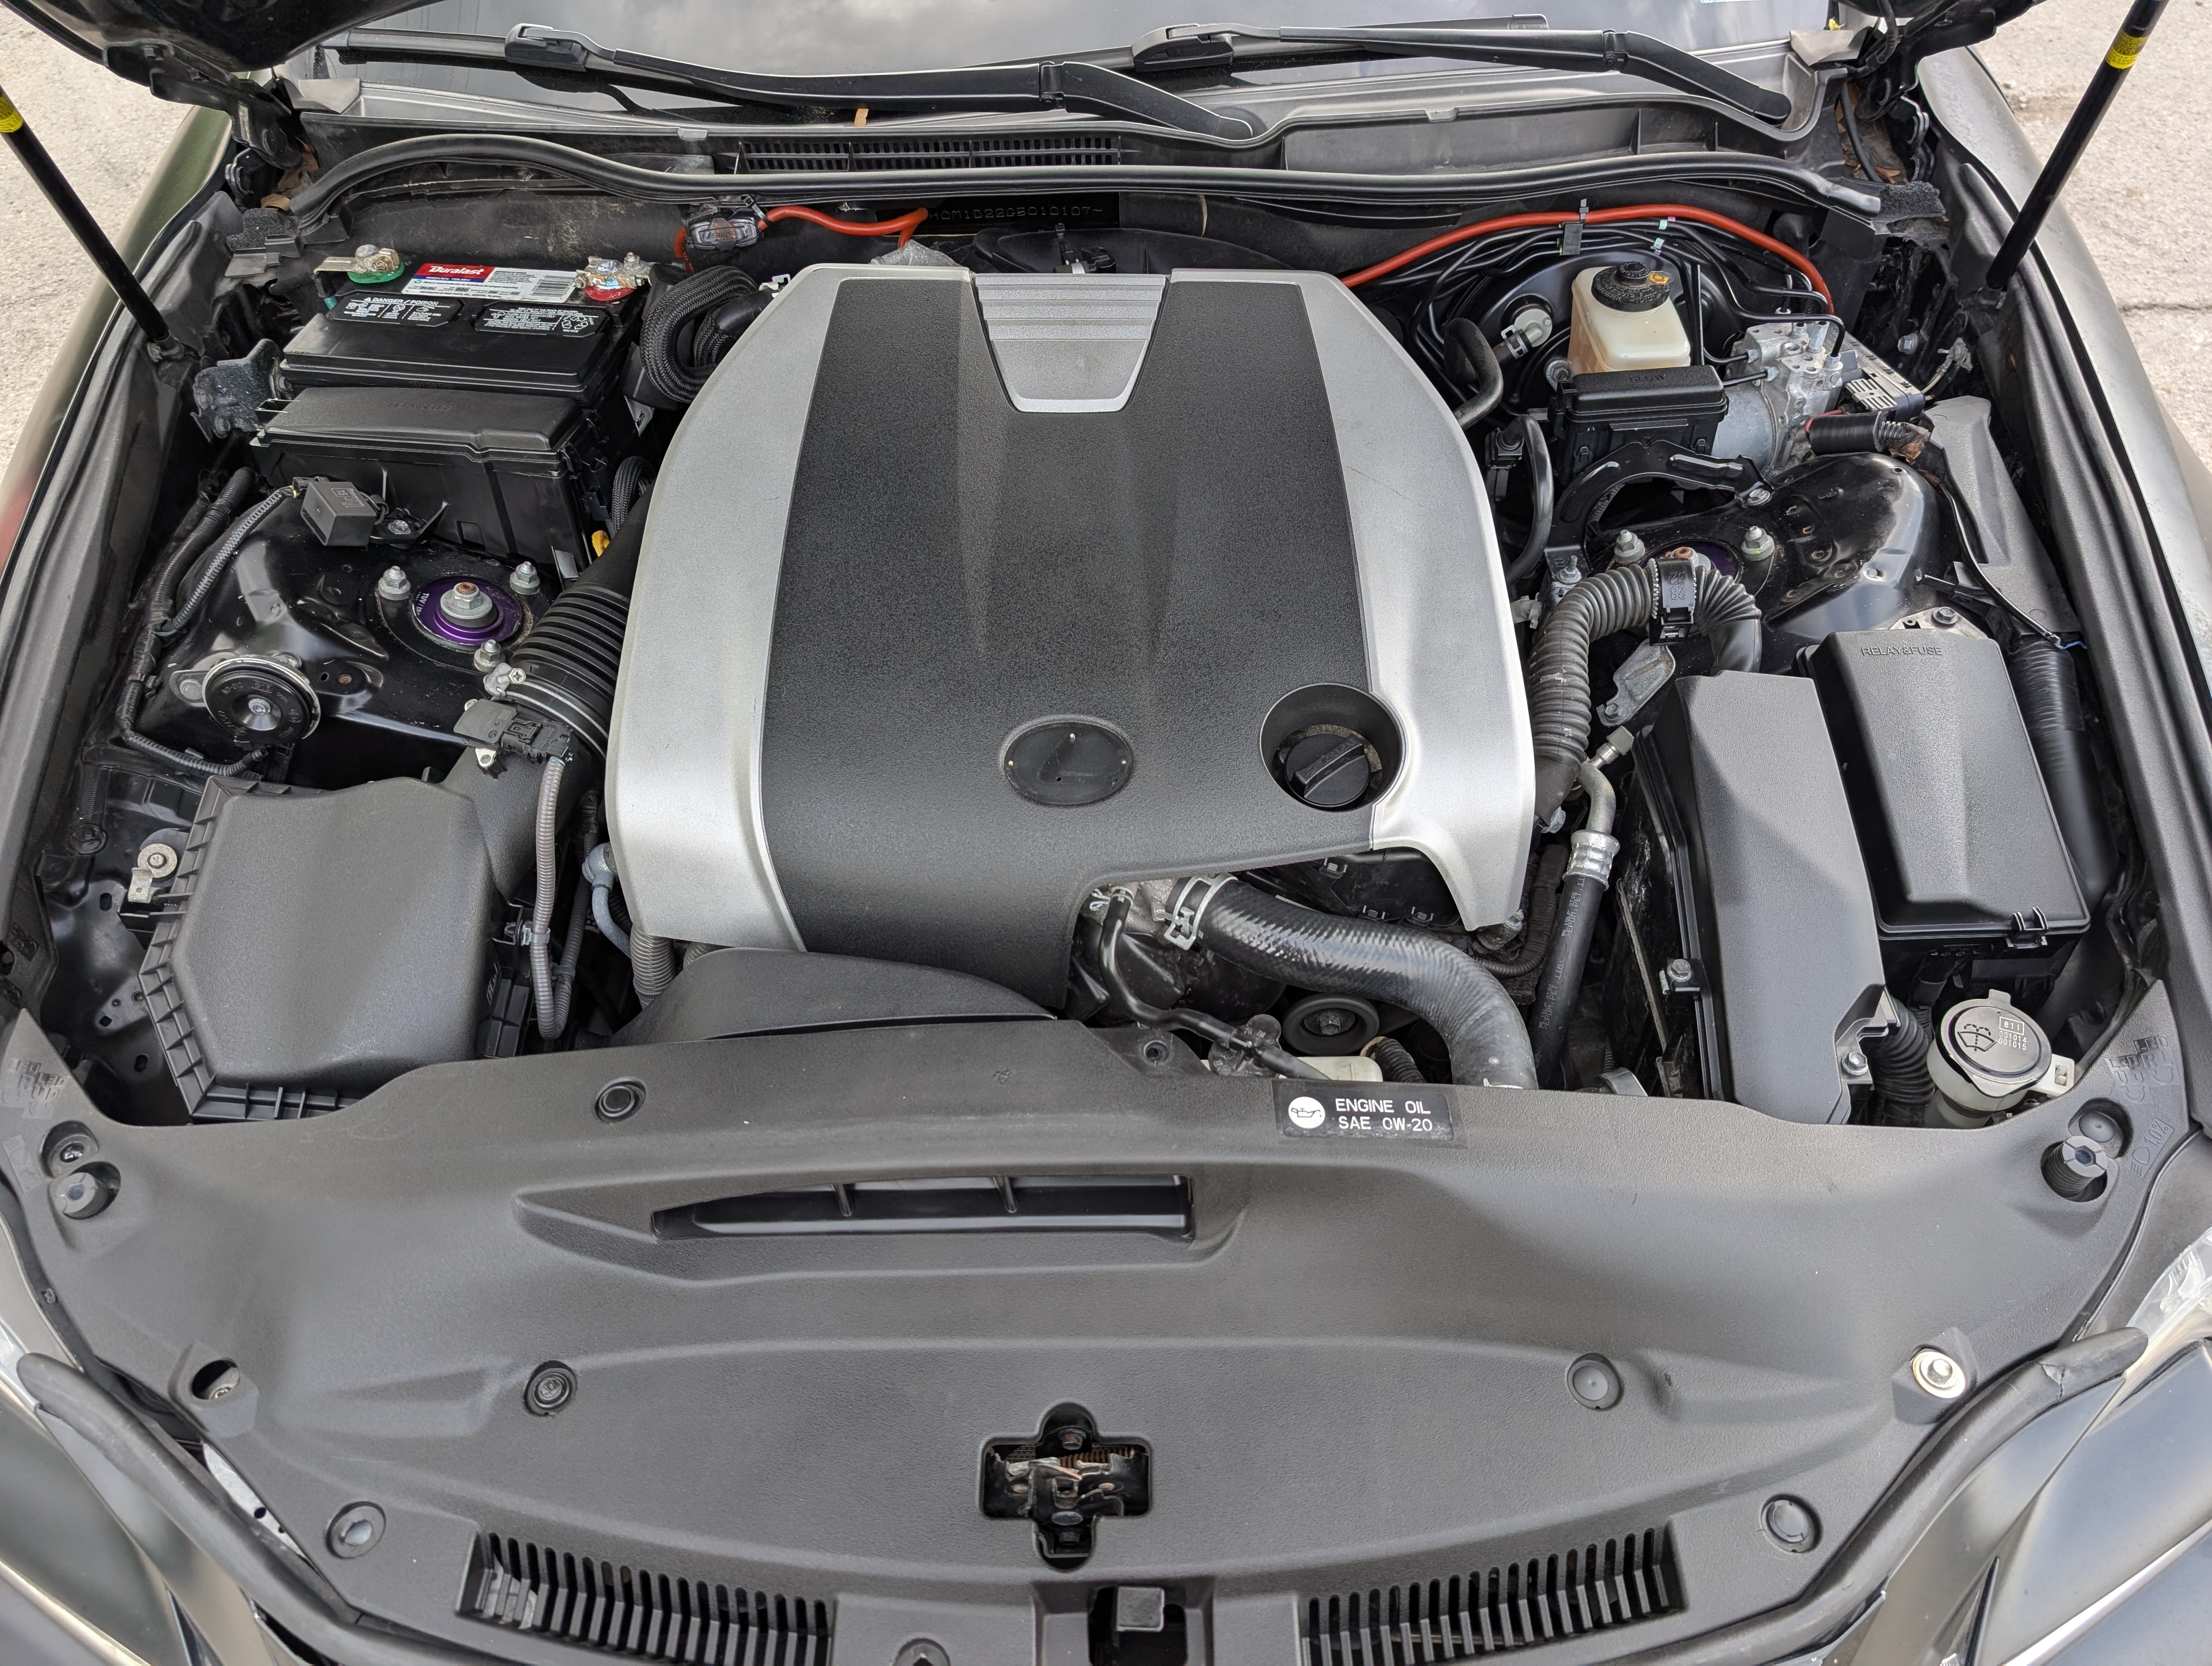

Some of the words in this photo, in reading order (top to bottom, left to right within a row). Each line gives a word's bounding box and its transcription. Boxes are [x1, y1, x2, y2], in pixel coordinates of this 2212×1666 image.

[429, 266, 484, 275] Duralast
[419, 593, 430, 604] TUV
[1861, 646, 1945, 656] RELAY&FUSE
[2004, 1021, 2020, 1030] e11
[1999, 1031, 2027, 1043] 001014
[1998, 1038, 2027, 1050] 001015
[2133, 1036, 2169, 1053] LED
[2106, 1054, 2140, 1069] LED
[34, 1072, 67, 1086] LED
[1335, 1098, 1394, 1113] ENGINE
[1405, 1101, 1431, 1114] OIL
[1339, 1116, 1372, 1130] SAE
[1382, 1117, 1433, 1132] 0W-20
